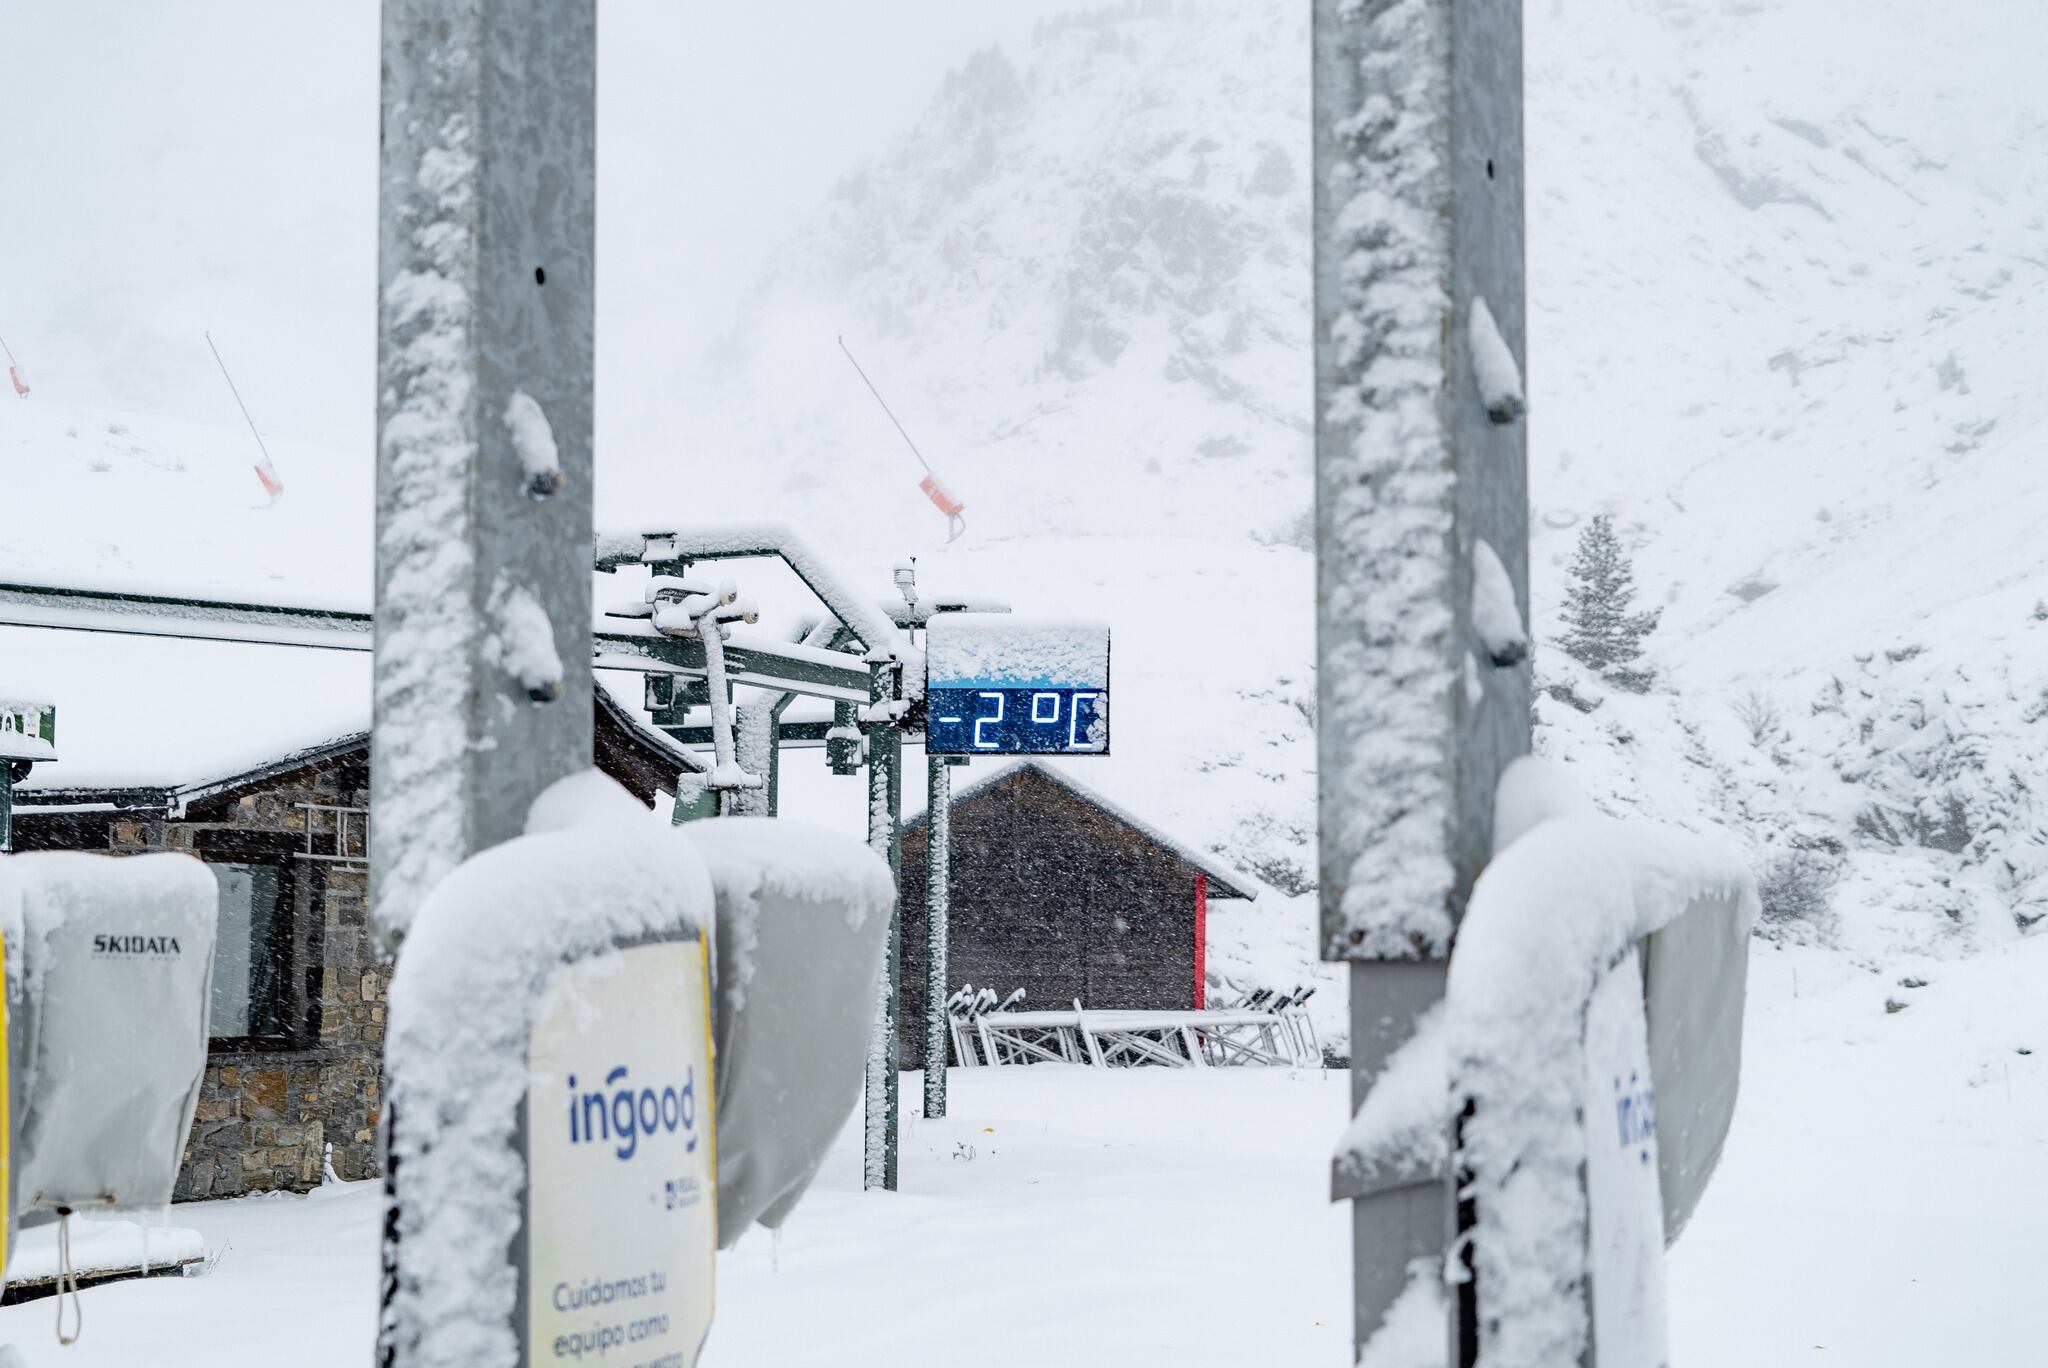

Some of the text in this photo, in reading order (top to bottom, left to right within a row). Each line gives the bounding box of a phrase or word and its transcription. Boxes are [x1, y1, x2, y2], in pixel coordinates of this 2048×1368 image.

[939, 692, 1004, 748] -2
[94, 934, 180, 953] SKIDATA
[568, 1066, 697, 1160] ingood
[552, 1271, 667, 1312] Cuidamos tu
[552, 1314, 670, 1363] equipo como
